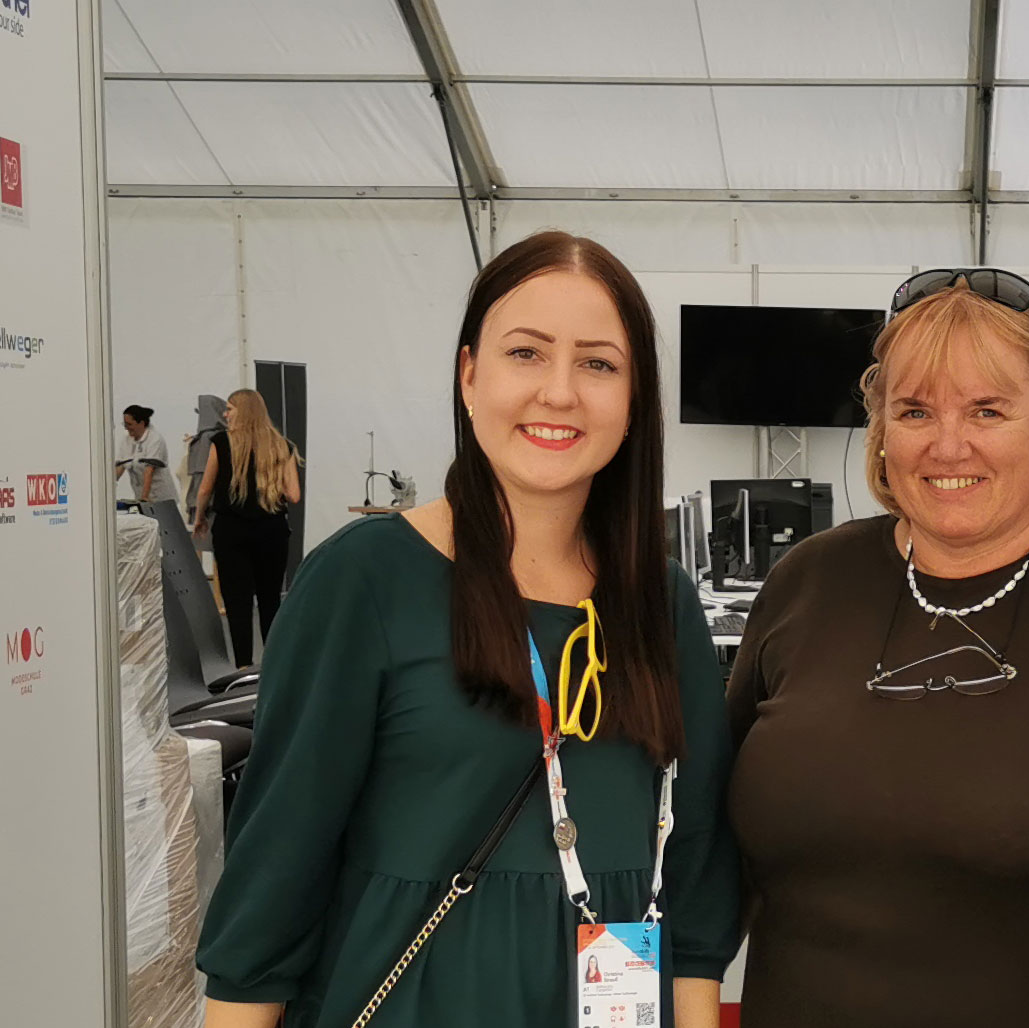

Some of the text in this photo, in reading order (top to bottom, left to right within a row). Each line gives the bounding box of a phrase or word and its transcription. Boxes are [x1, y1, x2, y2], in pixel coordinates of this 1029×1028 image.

[11, 15, 24, 37] side
[0, 327, 44, 359] llweger
[27, 477, 56, 502] WKO
